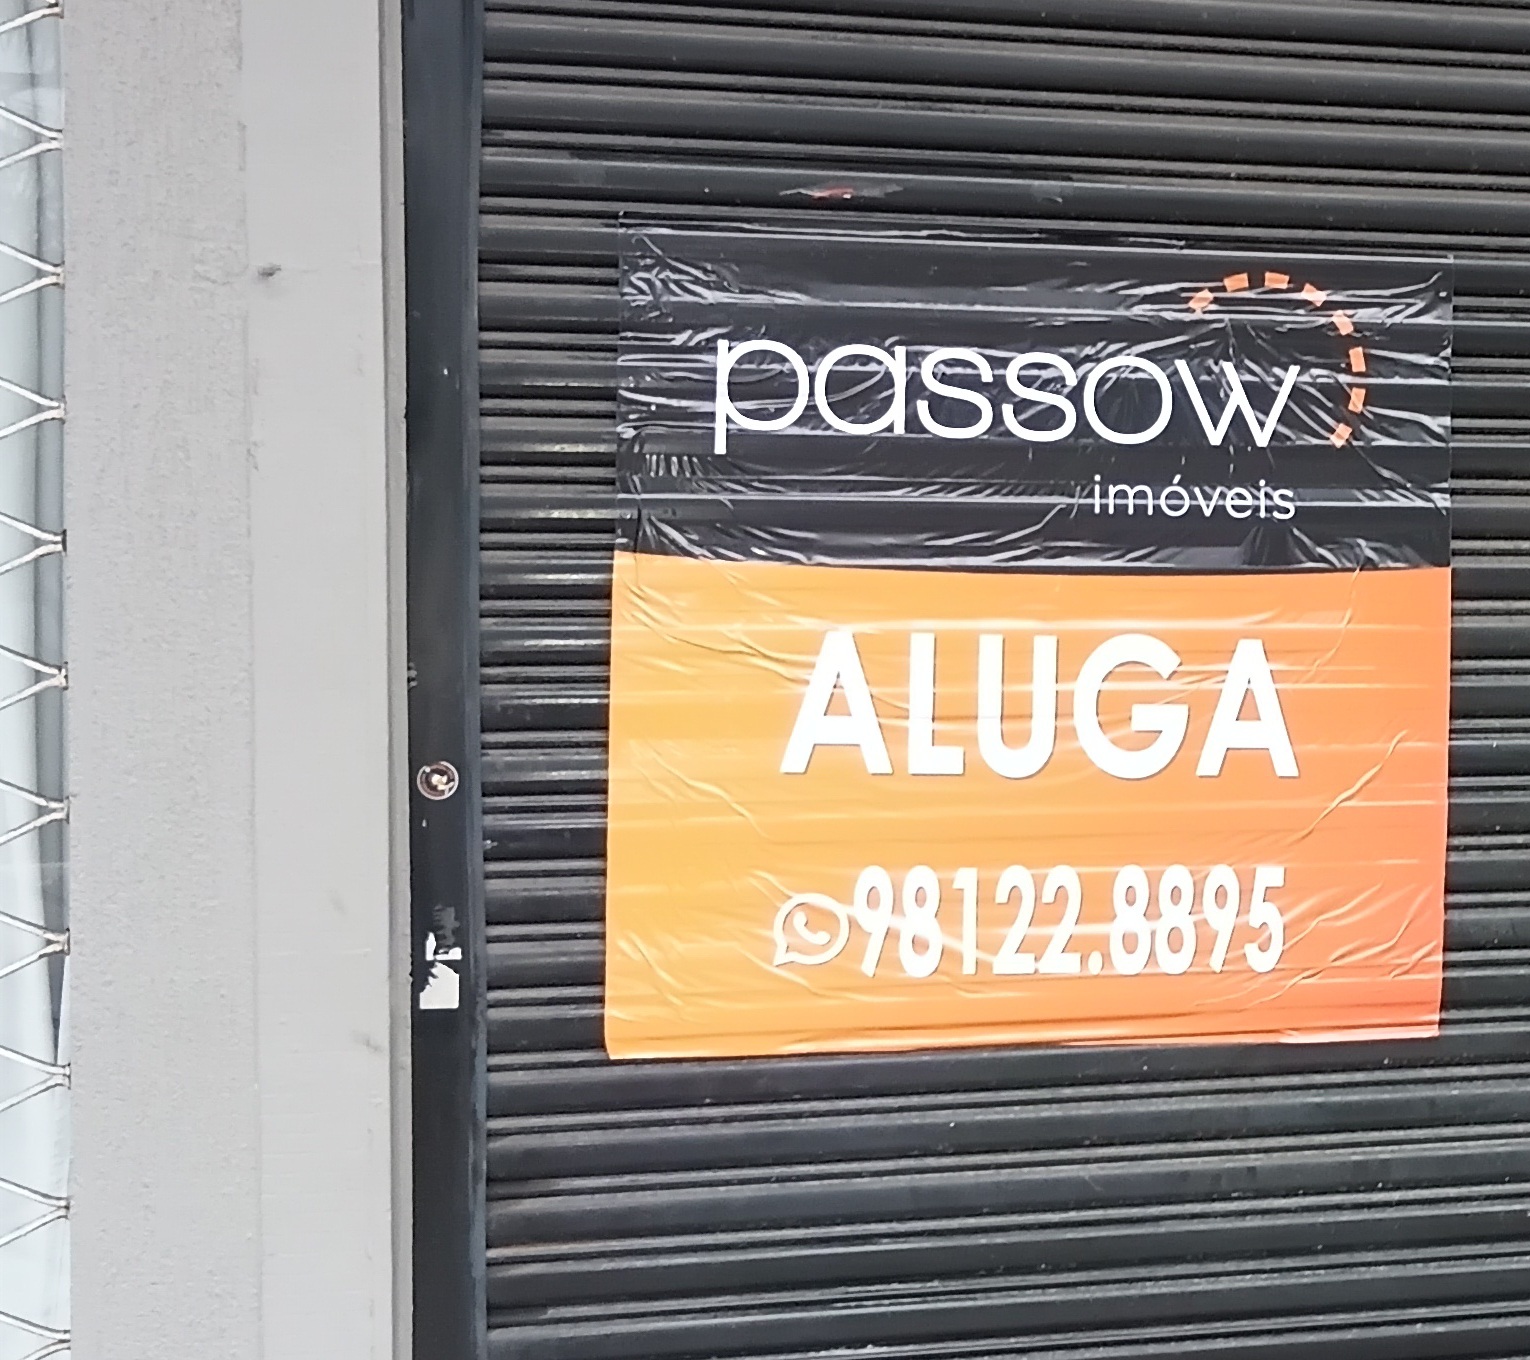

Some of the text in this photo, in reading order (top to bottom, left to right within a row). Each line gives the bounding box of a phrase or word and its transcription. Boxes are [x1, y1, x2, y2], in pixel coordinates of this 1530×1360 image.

[714, 338, 1301, 455] passow
[1091, 474, 1297, 520] imóveis
[780, 630, 1300, 780] ALUGA
[853, 864, 1287, 978] 98122.8895
